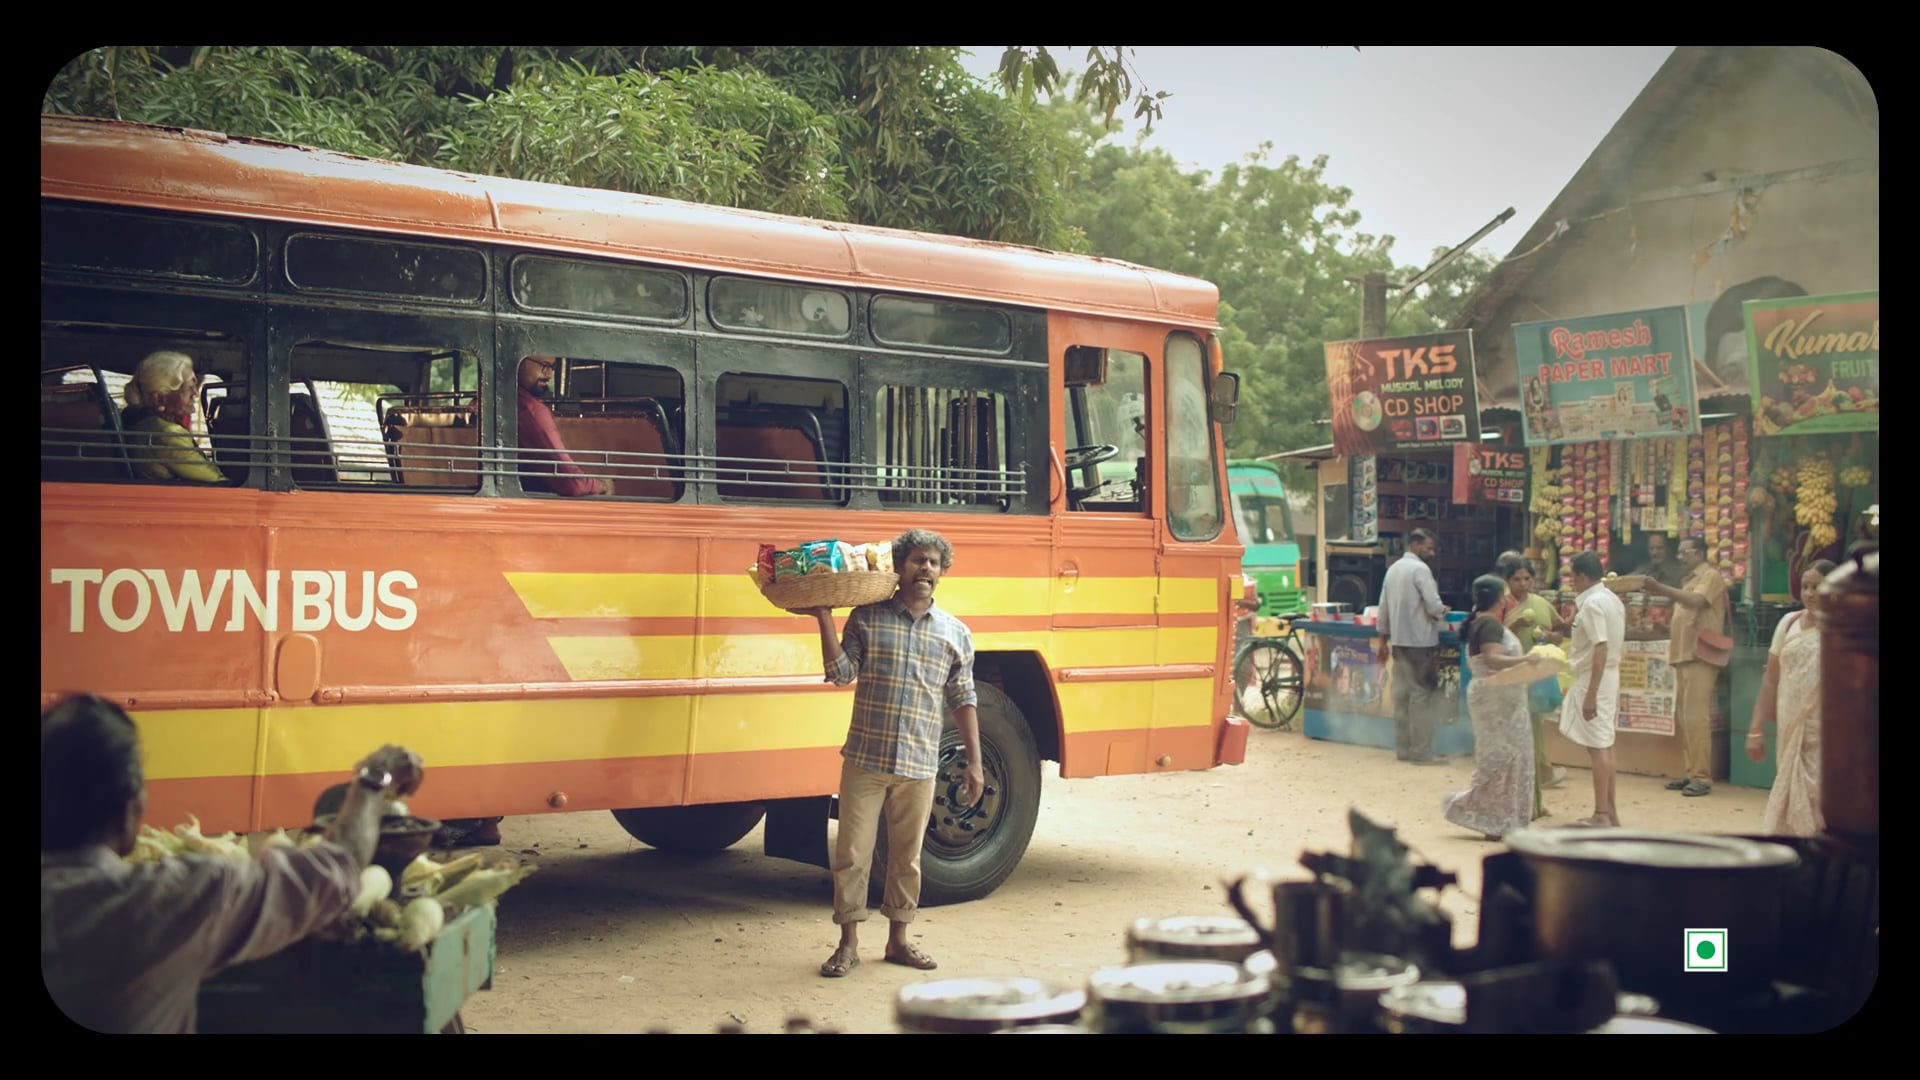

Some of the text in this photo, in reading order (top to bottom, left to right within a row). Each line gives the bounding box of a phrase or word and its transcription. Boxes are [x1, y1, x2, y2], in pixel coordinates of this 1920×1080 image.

[1550, 318, 1652, 360] Ramesh
[1376, 344, 1457, 381] TKS
[1538, 352, 1672, 385] PAPER MART
[1381, 378, 1464, 394] MUSICAL MELODY
[1384, 394, 1464, 416] CD SHOP
[1481, 451, 1525, 469] TKS
[1484, 478, 1524, 488] CD SHOP
[51, 567, 418, 633] TOWN BUS
